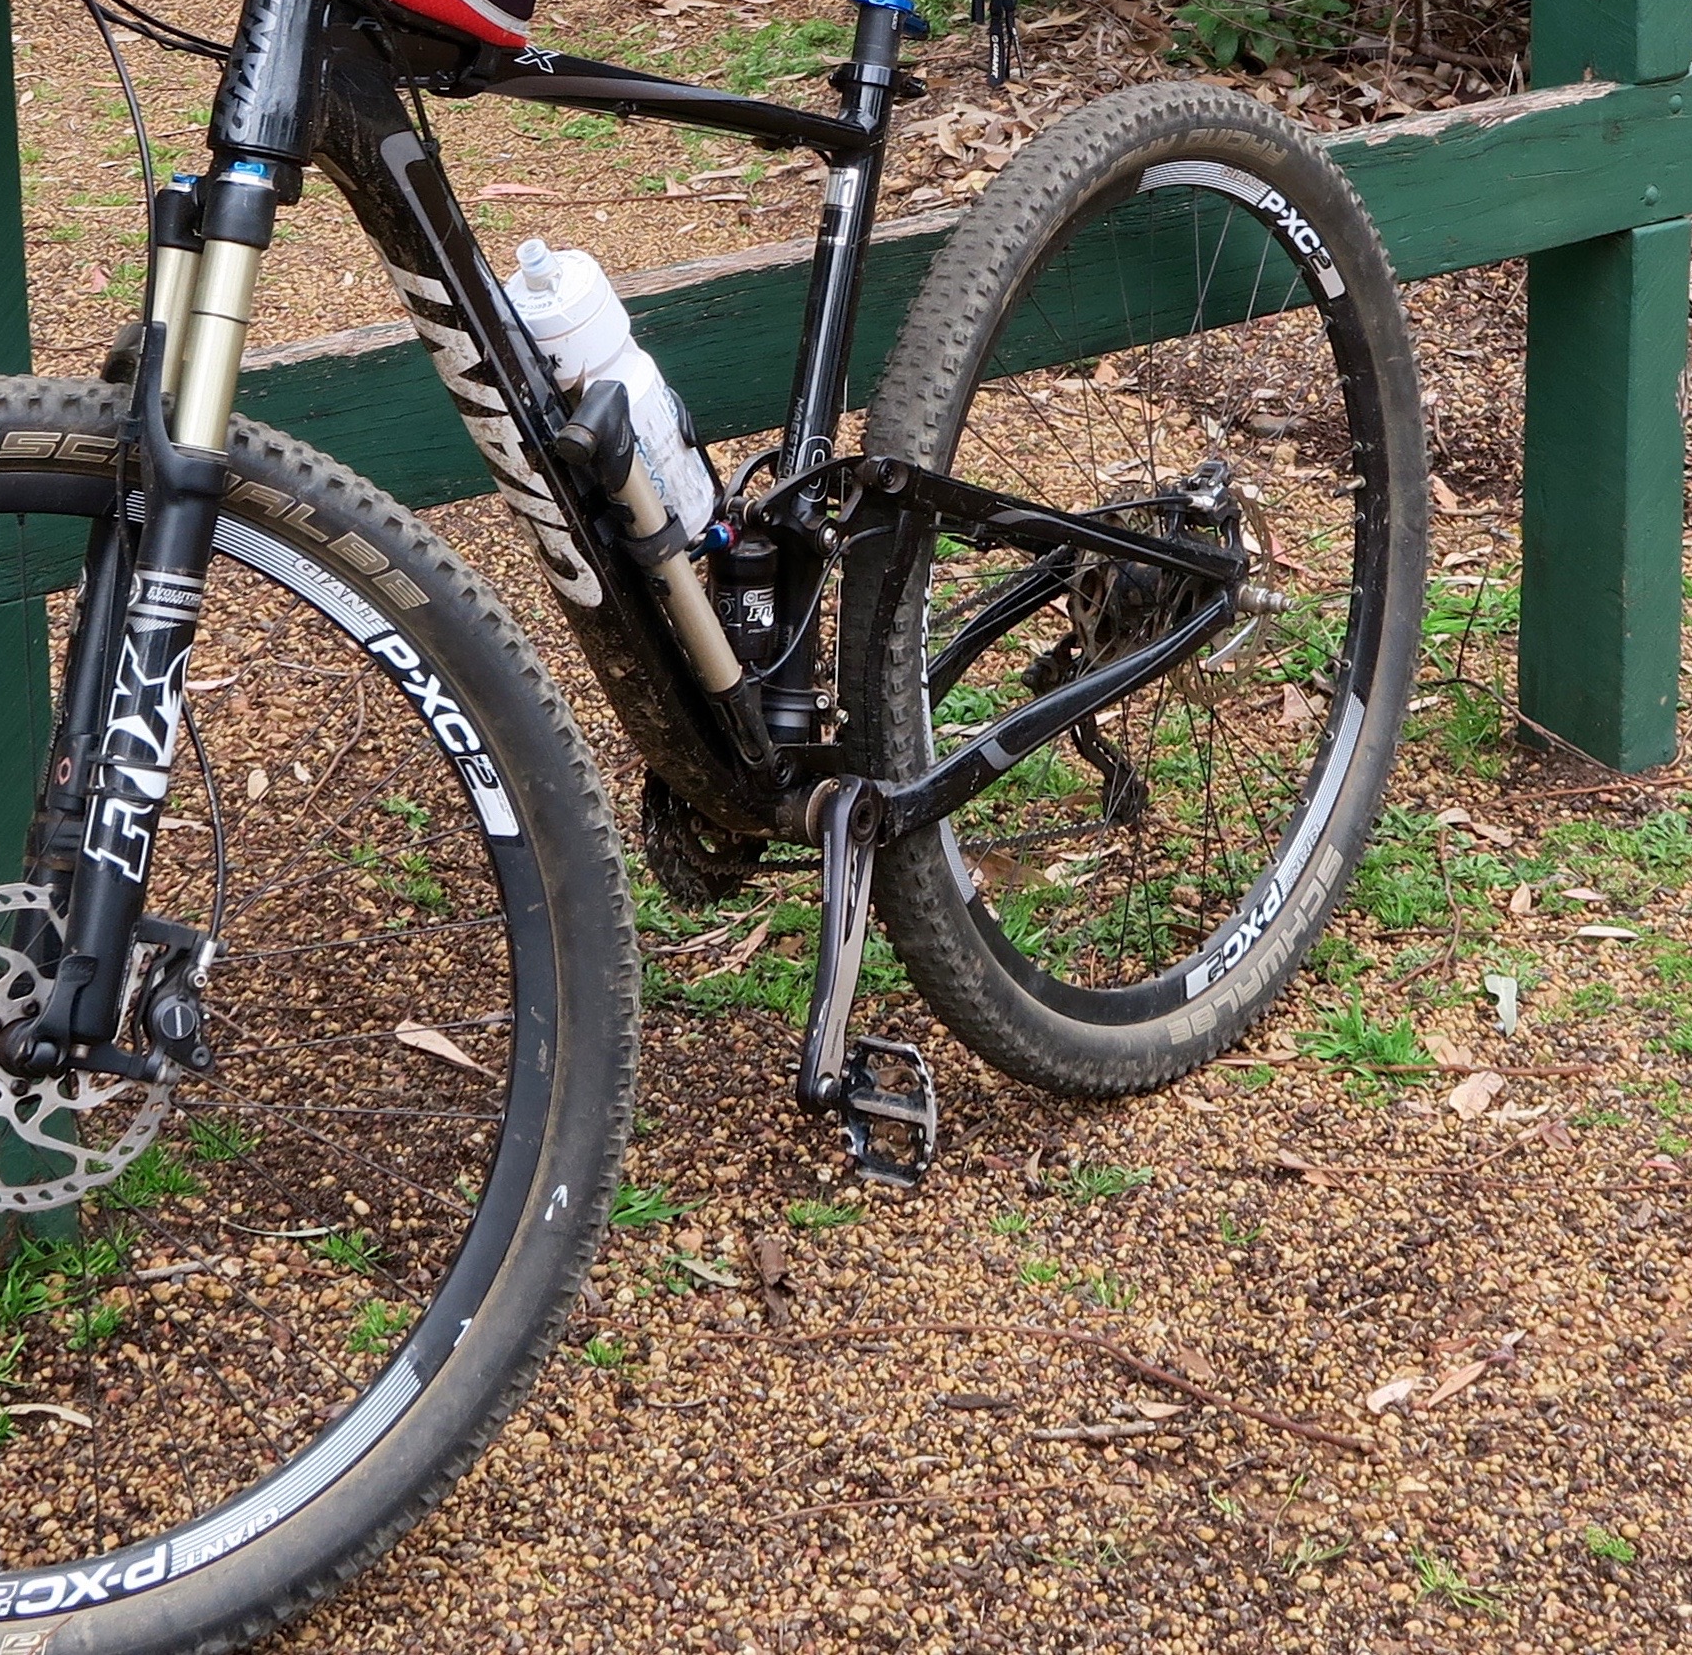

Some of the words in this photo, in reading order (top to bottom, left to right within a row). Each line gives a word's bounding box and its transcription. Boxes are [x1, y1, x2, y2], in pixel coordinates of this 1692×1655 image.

[514, 45, 560, 74] X
[1259, 191, 1331, 274] P-XC2
[293, 556, 388, 625] GIANT
[367, 634, 499, 790] P-XC2
[84, 635, 193, 883] FOX
[1167, 843, 1344, 1045] SCHWALBE
[1207, 881, 1284, 983] P-XC2
[182, 1505, 280, 1572] GIANT
